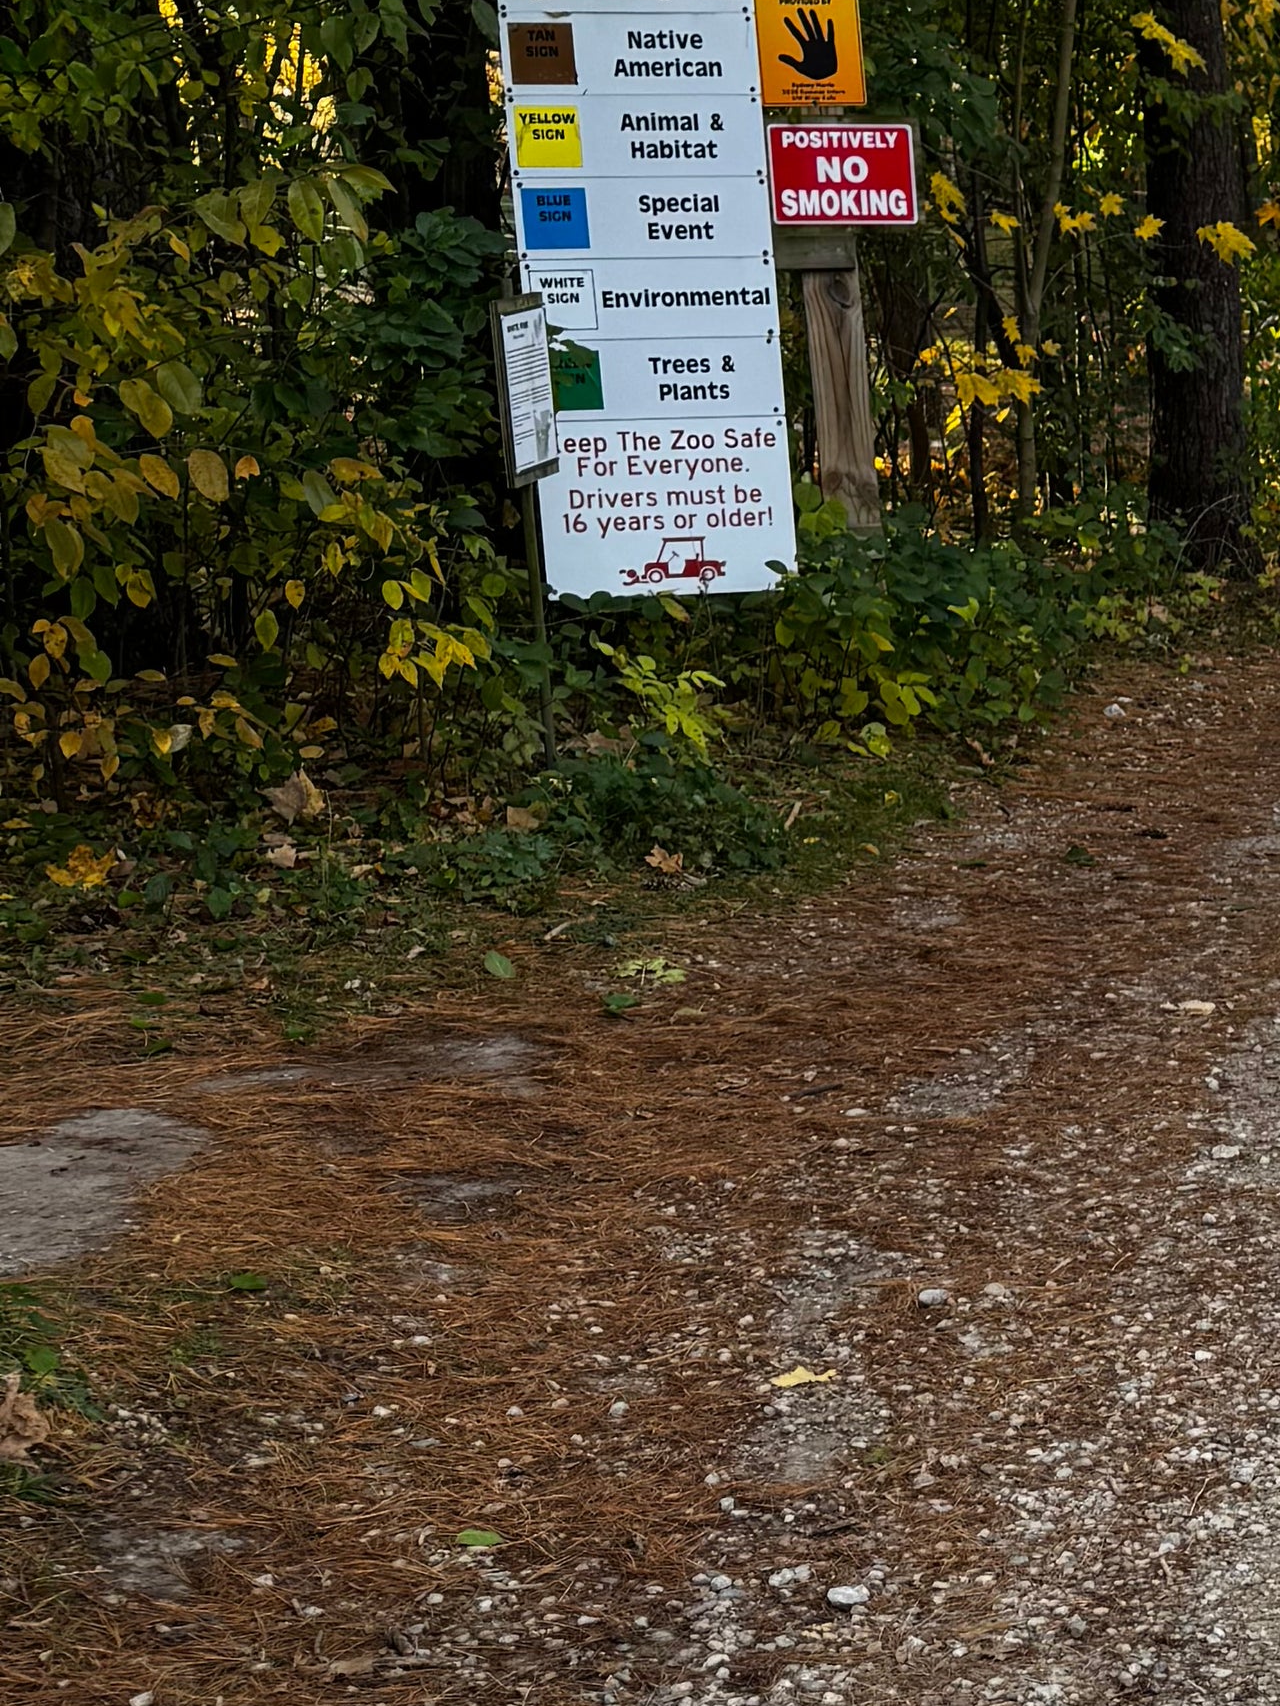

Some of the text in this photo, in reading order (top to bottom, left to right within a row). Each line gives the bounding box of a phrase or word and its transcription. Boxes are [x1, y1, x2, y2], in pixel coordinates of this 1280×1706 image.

[527, 30, 555, 42] TAN
[627, 30, 703, 50] Native
[525, 46, 559, 57] SIGN
[614, 58, 723, 78] American
[519, 113, 576, 124] YELLOW
[620, 112, 724, 131] Animal &
[532, 129, 565, 140] SIGN
[781, 131, 898, 149] POSITIVELY
[630, 140, 718, 159] Habitat
[816, 155, 869, 184] NO
[536, 195, 571, 206] BLUE
[638, 194, 720, 216] Special
[781, 189, 908, 217] SMOKING
[539, 211, 572, 222] SIGN
[647, 221, 714, 240] Event
[539, 277, 585, 288] WHITE
[547, 293, 580, 304] SIGN
[601, 287, 770, 308] Environmental
[648, 355, 736, 374] Trees &
[659, 381, 730, 401] Plants
[559, 427, 777, 458] eep The Zoo Safe
[576, 455, 751, 481] For Everyone.
[569, 484, 763, 510] Drivers must be
[562, 506, 774, 539] 16 years or older!
